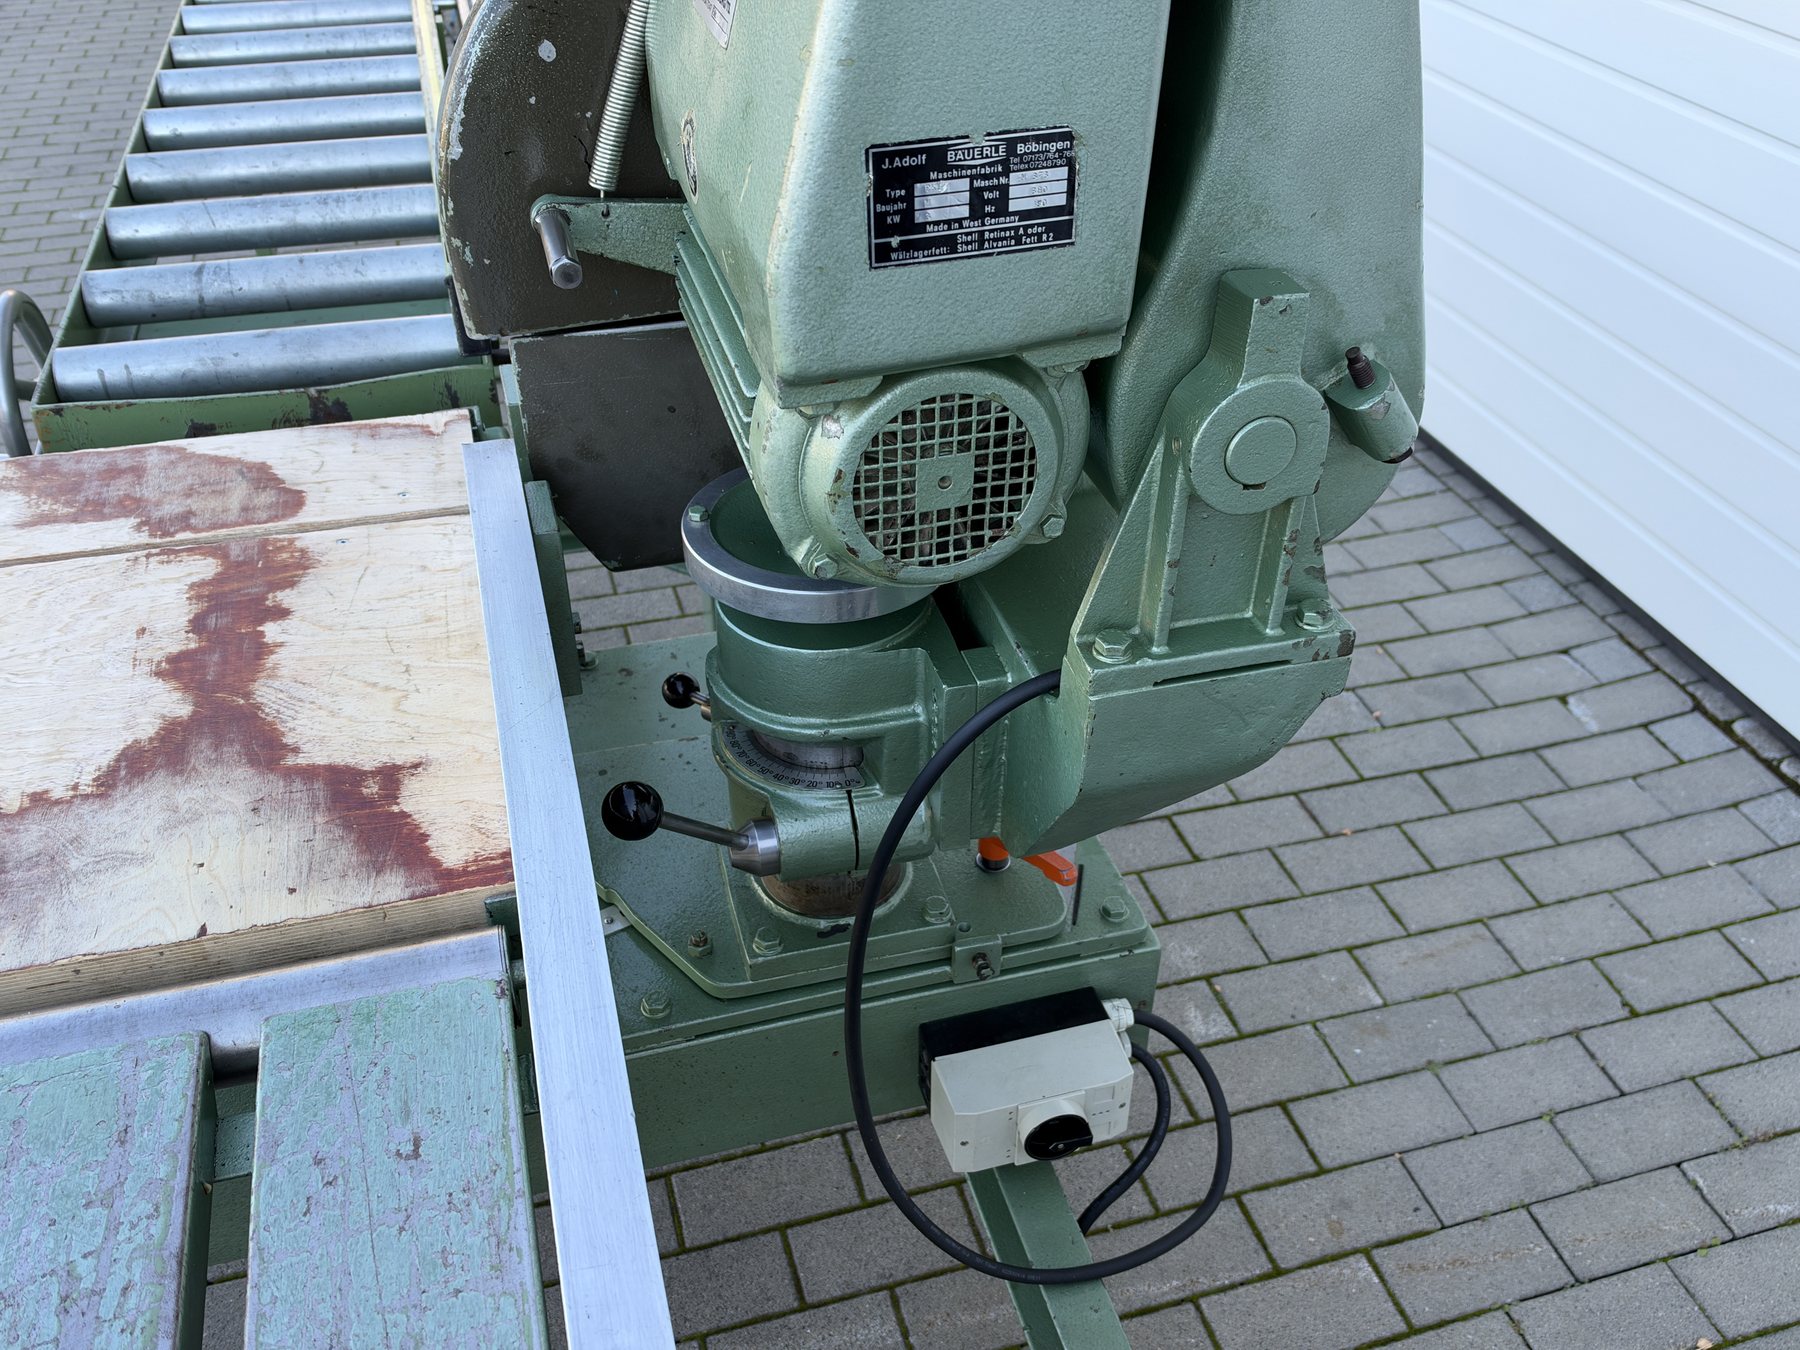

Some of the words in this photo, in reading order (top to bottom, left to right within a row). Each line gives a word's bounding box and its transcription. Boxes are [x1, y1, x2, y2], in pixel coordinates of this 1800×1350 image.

[947, 144, 1007, 162] BÄUERLE
[1016, 140, 1071, 154] Böbingen
[1009, 162, 1029, 171] Telex
[1029, 158, 1067, 169] 07248790
[929, 164, 1003, 180] Maschinenfabrik
[973, 177, 999, 188] Masch
[885, 188, 906, 199] Type
[983, 190, 1000, 200] Volt
[875, 201, 907, 214] Baujahr
[984, 204, 996, 214] Hz
[886, 214, 901, 225] KW
[926, 222, 949, 233] Made
[951, 221, 959, 230] in
[962, 218, 982, 229] West
[984, 215, 1020, 226] Germany
[956, 232, 979, 243] Shell
[984, 229, 1015, 240] Retinax
[1018, 226, 1025, 235] A
[1027, 225, 1046, 235] oder
[956, 242, 979, 253] Shell
[983, 238, 1016, 250] Alvania
[1022, 235, 1038, 245] Fett
[746, 758, 761, 767] 60°
[757, 766, 774, 775] 50°
[772, 773, 790, 781] 40°
[788, 776, 806, 786] 30°
[845, 778, 855, 787] 0°
